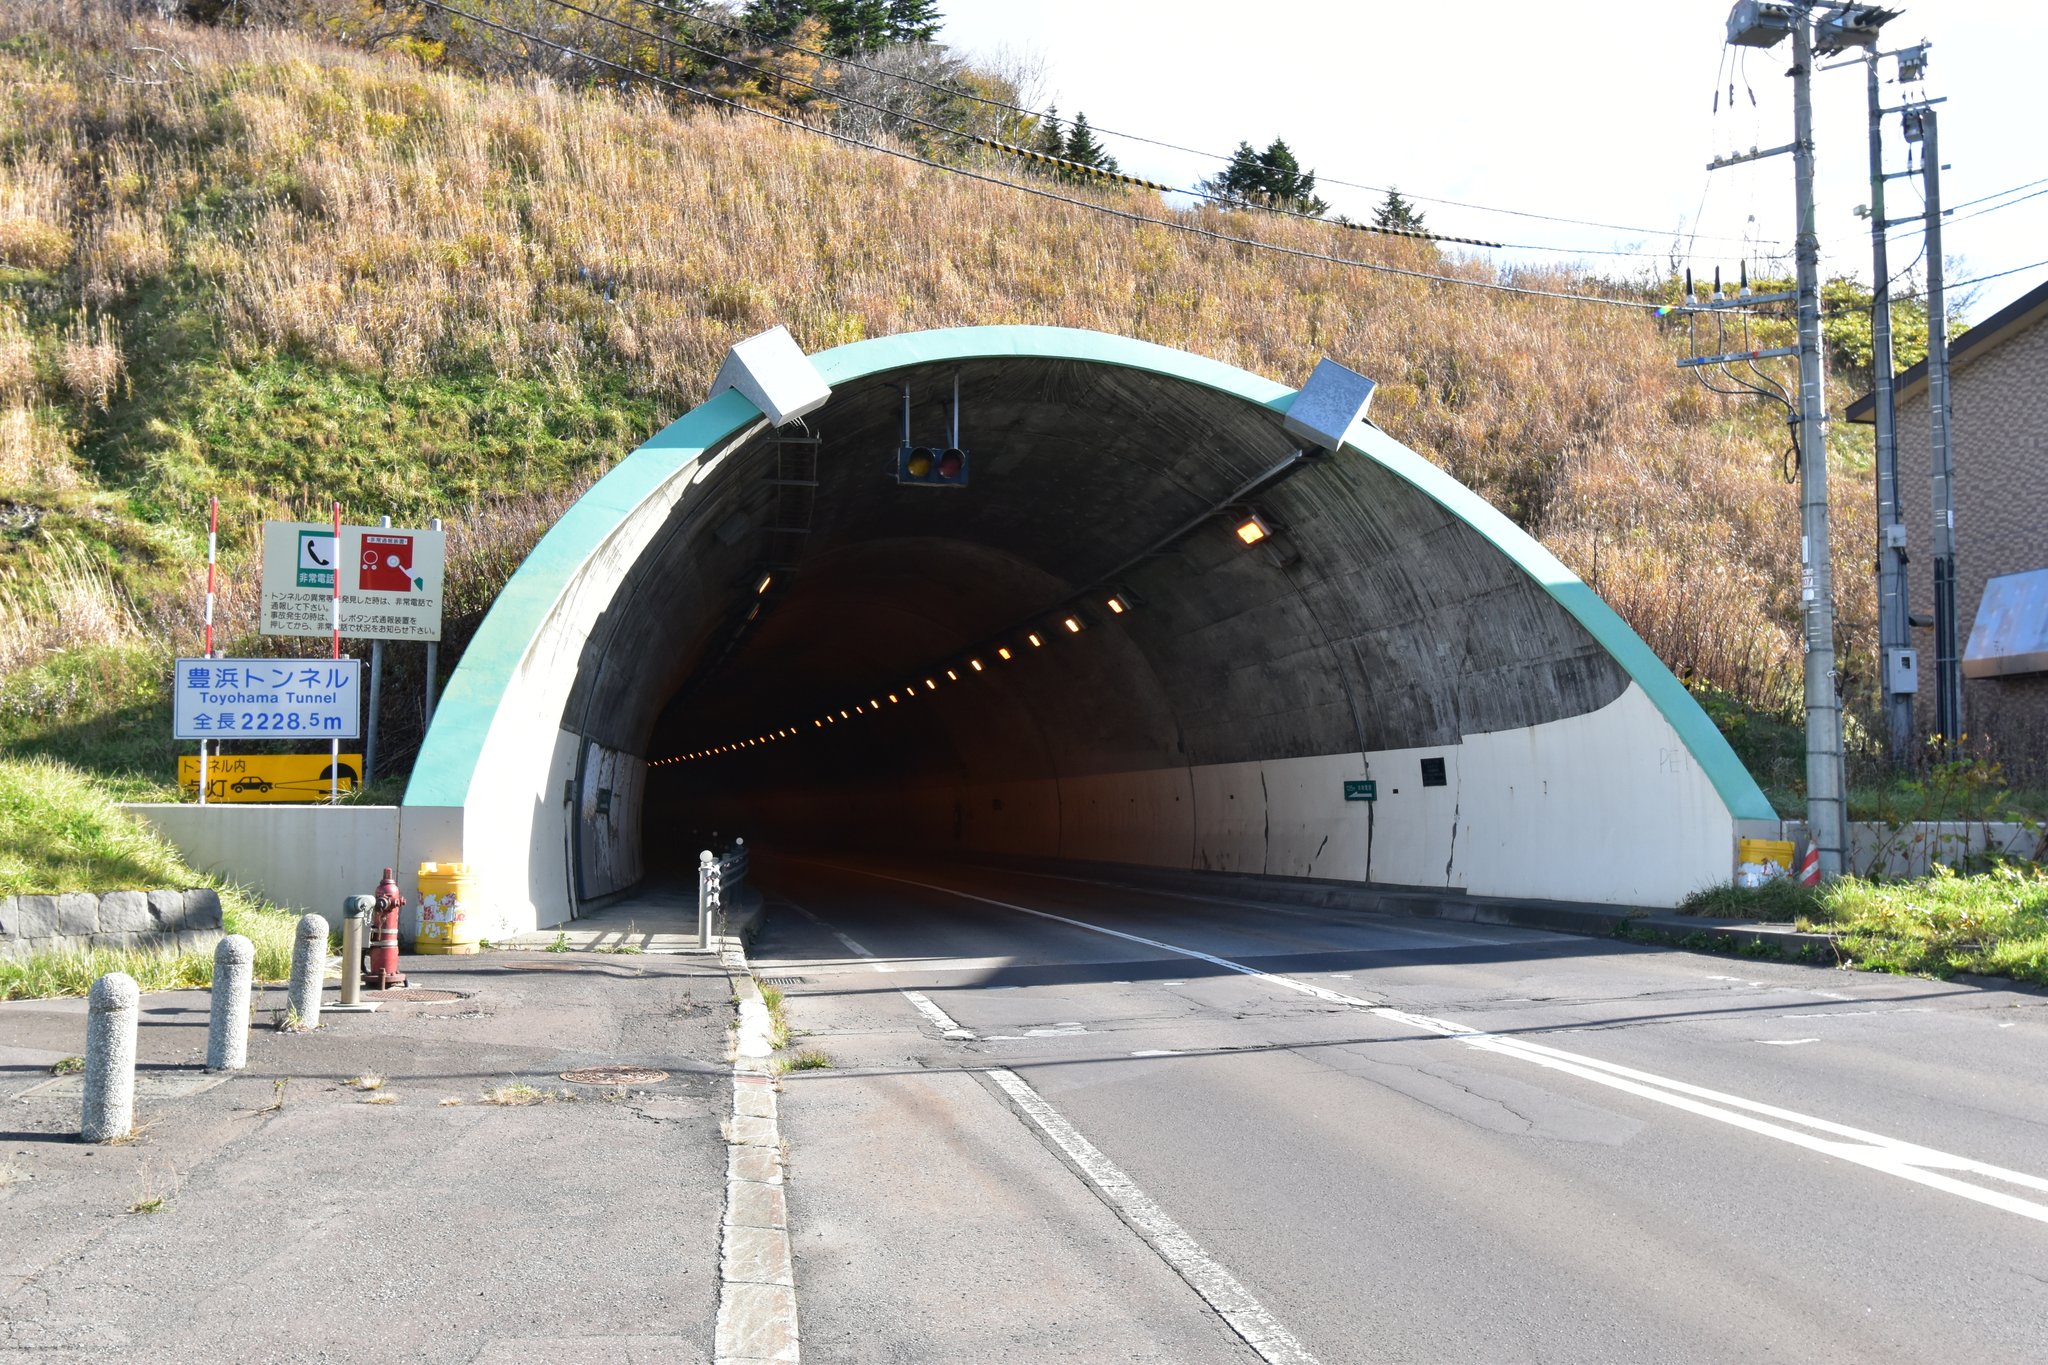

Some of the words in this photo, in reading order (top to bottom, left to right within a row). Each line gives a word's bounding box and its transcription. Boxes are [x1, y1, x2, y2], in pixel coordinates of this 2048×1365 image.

[270, 620, 436, 635] 押してから、非常話で状況をお知らせ下さい。
[187, 667, 349, 688] 豊浜トンネル
[200, 692, 279, 705] Toyohama
[286, 692, 336, 703] Tunnel
